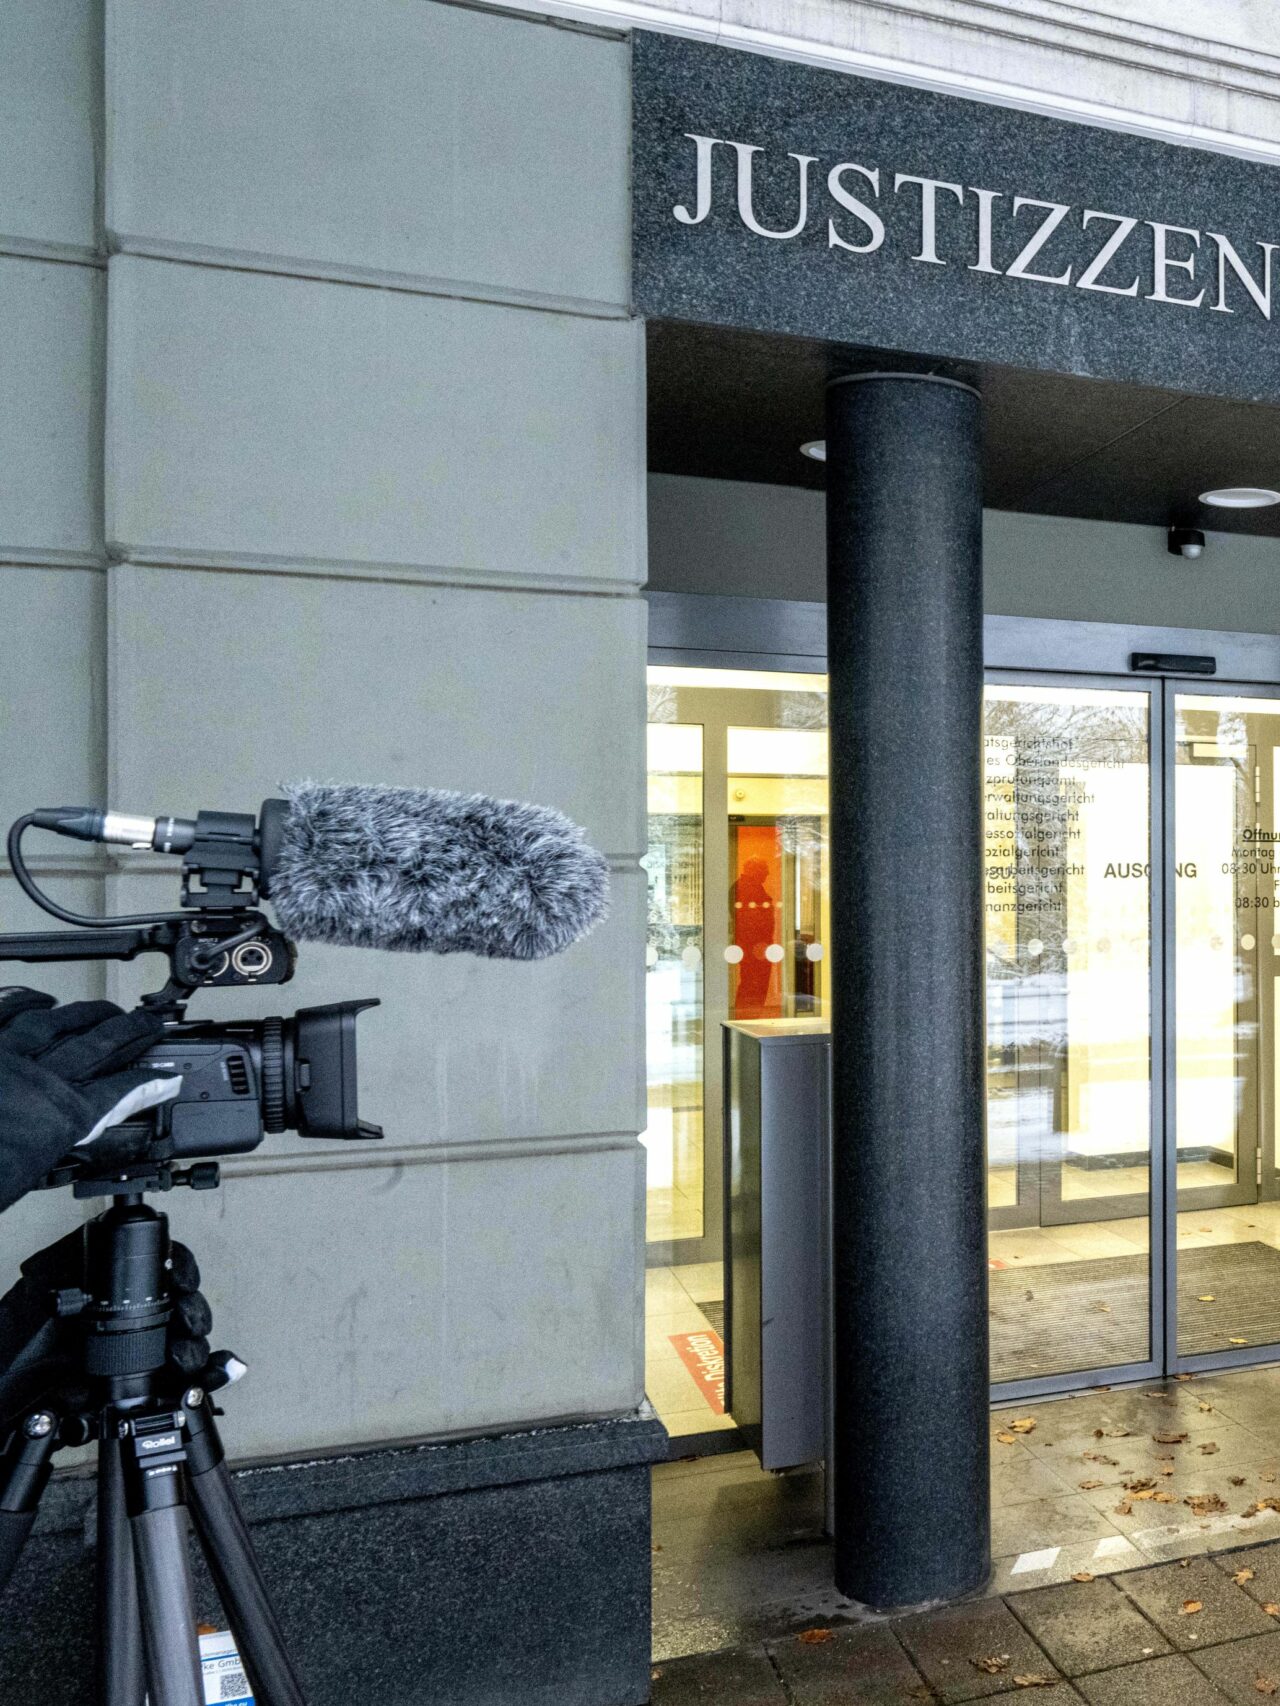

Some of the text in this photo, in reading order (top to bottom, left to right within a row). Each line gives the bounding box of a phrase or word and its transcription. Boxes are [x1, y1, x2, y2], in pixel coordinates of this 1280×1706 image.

[984, 791, 1095, 806] rwaltungsgericht
[1231, 846, 1275, 860] Montag
[1221, 863, 1257, 875] 08:30
[1260, 863, 1280, 875] Uhr
[1235, 897, 1269, 909] 08:30
